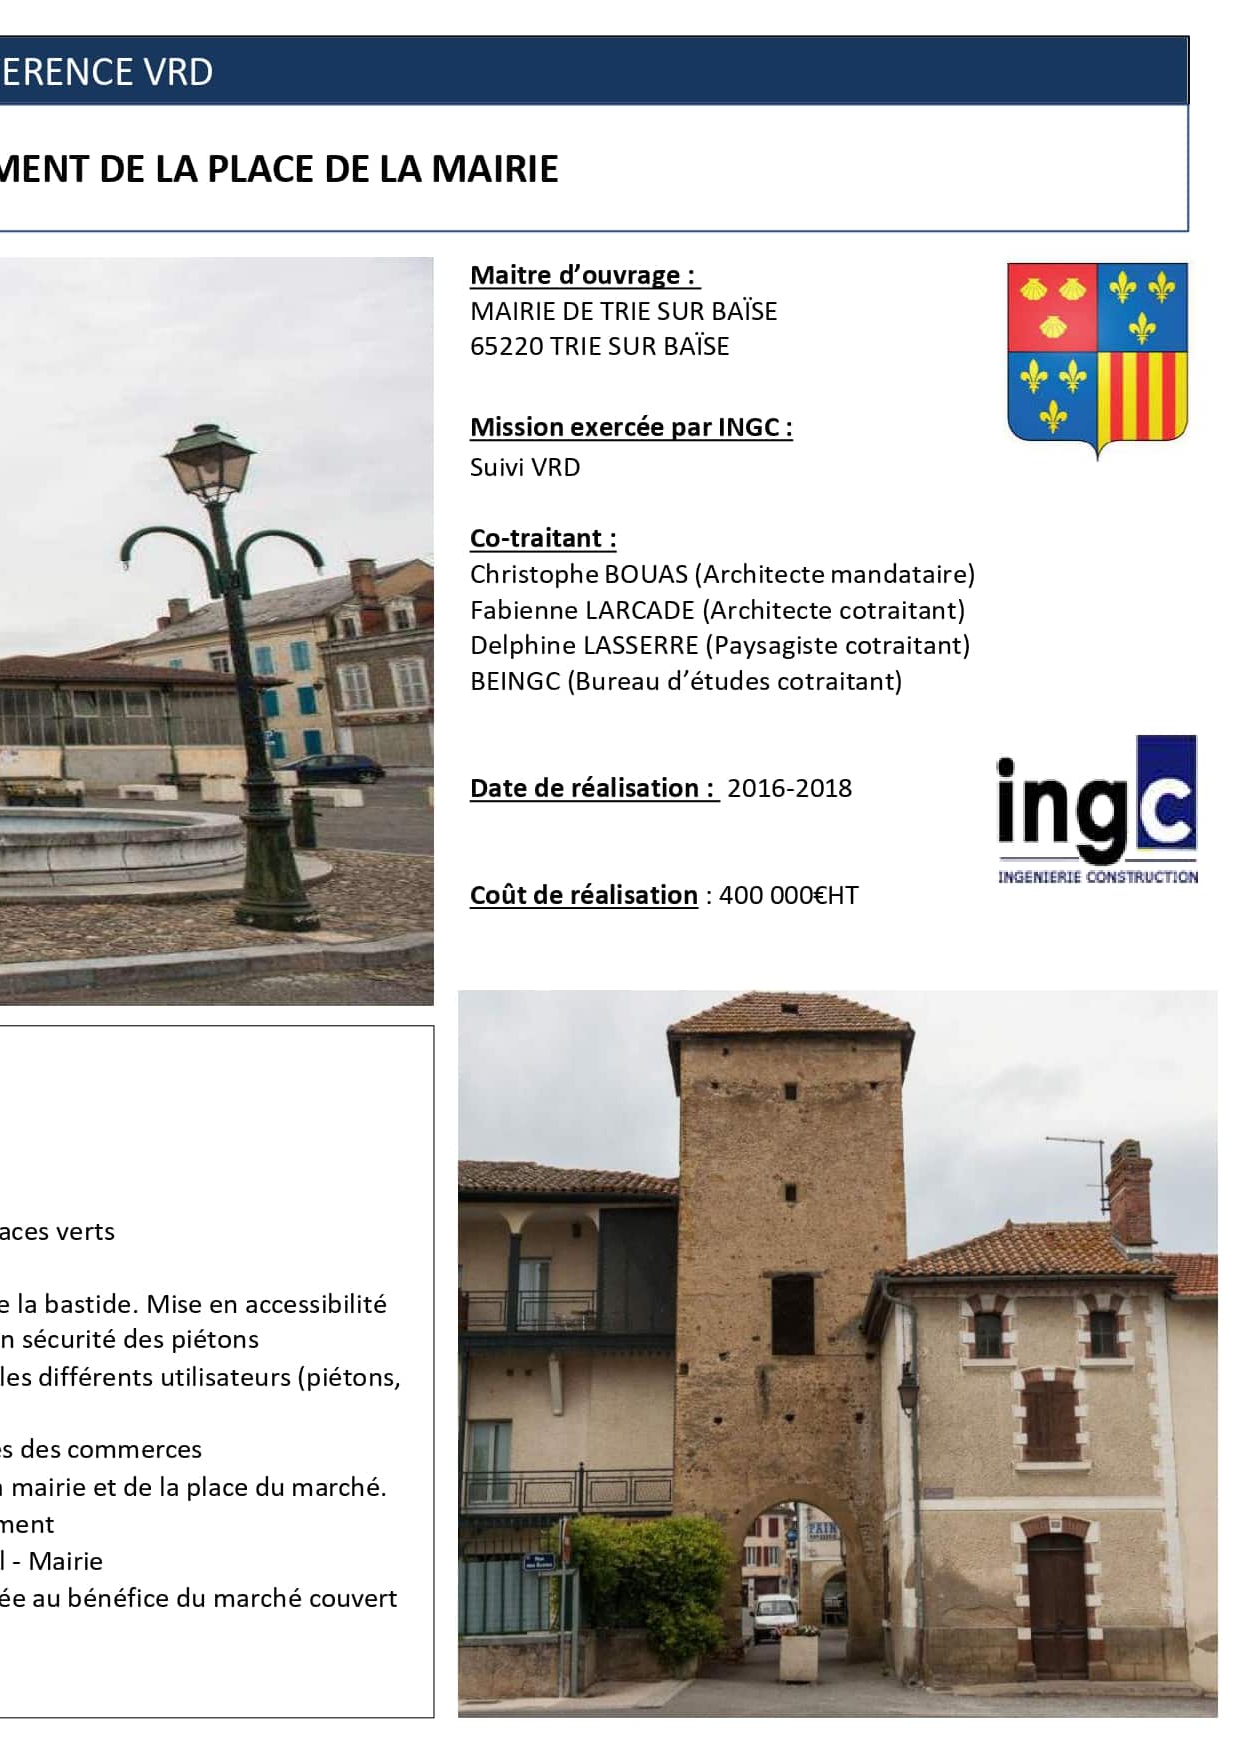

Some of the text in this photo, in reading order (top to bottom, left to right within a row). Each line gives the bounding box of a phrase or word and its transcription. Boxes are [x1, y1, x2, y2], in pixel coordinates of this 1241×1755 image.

[143, 57, 213, 86] VRD
[101, 154, 145, 183] DE
[157, 154, 199, 183] LA
[209, 154, 314, 183] PLACE
[326, 154, 370, 183] DE
[381, 154, 423, 183] LA
[433, 154, 559, 183] MAIRIE
[471, 263, 552, 285] Maitre
[559, 263, 680, 288] d’ouvrage
[471, 296, 778, 321] MAIRIE DE TRIE SUR BAÏSE
[470, 331, 730, 356] 65220 TRIE SUR BAÏSE
[471, 415, 564, 437] Mission
[570, 414, 664, 437] exercée
[672, 421, 713, 440] par
[719, 417, 780, 437] INGC
[470, 457, 581, 477] Suivi VRD
[470, 527, 601, 550] Co-traitant
[470, 562, 975, 589] Christophe BOUAS (Architecte mandataire)
[471, 598, 965, 625] Fabienne LARCADE (Architecte cotraitant)
[471, 633, 970, 660] Delphine LASSERRE (Paysagiste cotraitant)
[471, 669, 902, 696] BEINGC (Bureau d’études cotraitant)
[471, 778, 528, 798] Date
[534, 776, 564, 798] de
[572, 775, 699, 798] réalisation
[727, 778, 853, 798] 2016-2018
[998, 869, 1199, 884] INGENIERIE CONSTRUCTION
[470, 882, 528, 905] Coût
[533, 883, 564, 905] de
[571, 882, 698, 905] réalisation
[718, 885, 764, 905] 400
[770, 885, 860, 905] 000€HT
[56, 1223, 115, 1241] verts
[0, 1365, 32, 1387] les
[38, 1365, 153, 1387] différents
[161, 1365, 291, 1387] utilisateurs
[298, 1365, 400, 1392] (piétons,
[20, 1437, 61, 1459] des
[67, 1444, 202, 1459] commerces
[29, 1551, 103, 1571] Mairie
